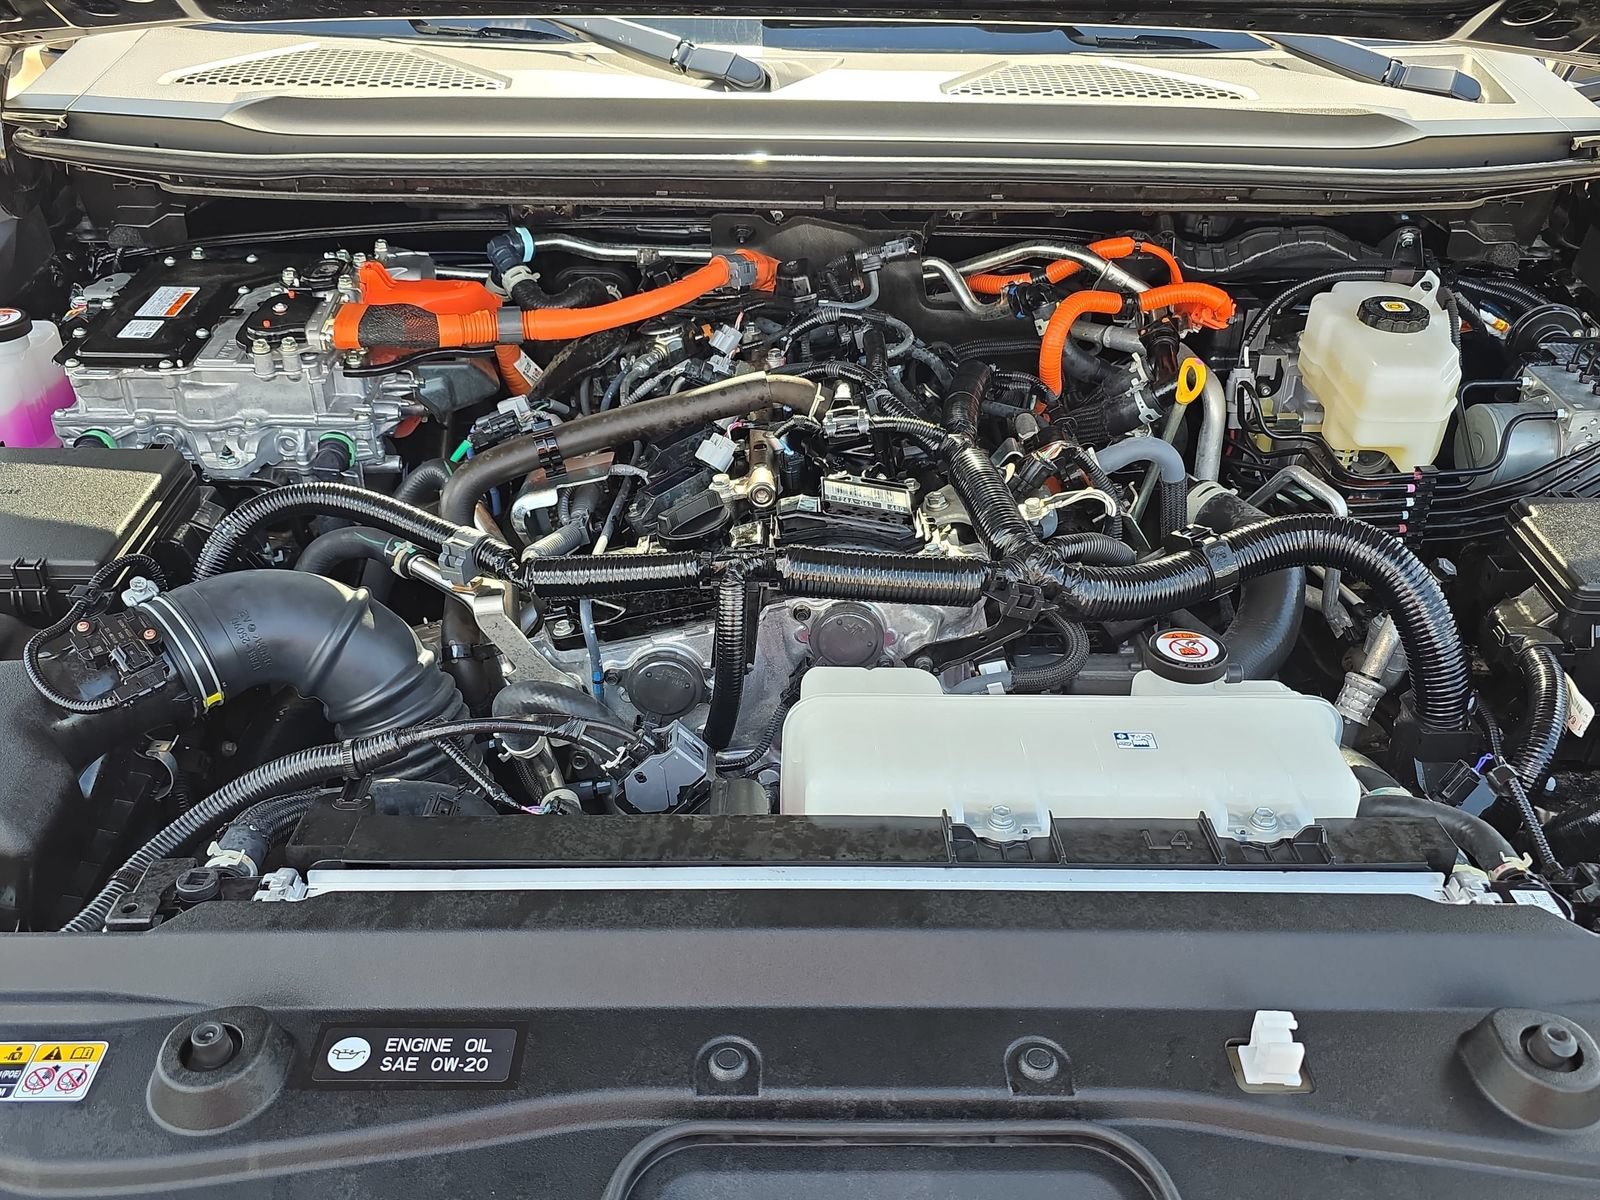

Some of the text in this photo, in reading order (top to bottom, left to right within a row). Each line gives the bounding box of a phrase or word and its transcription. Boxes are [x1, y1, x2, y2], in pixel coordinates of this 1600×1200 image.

[384, 1037, 493, 1053] ENGINE OIL
[379, 1056, 489, 1072] SAE 0W-20
